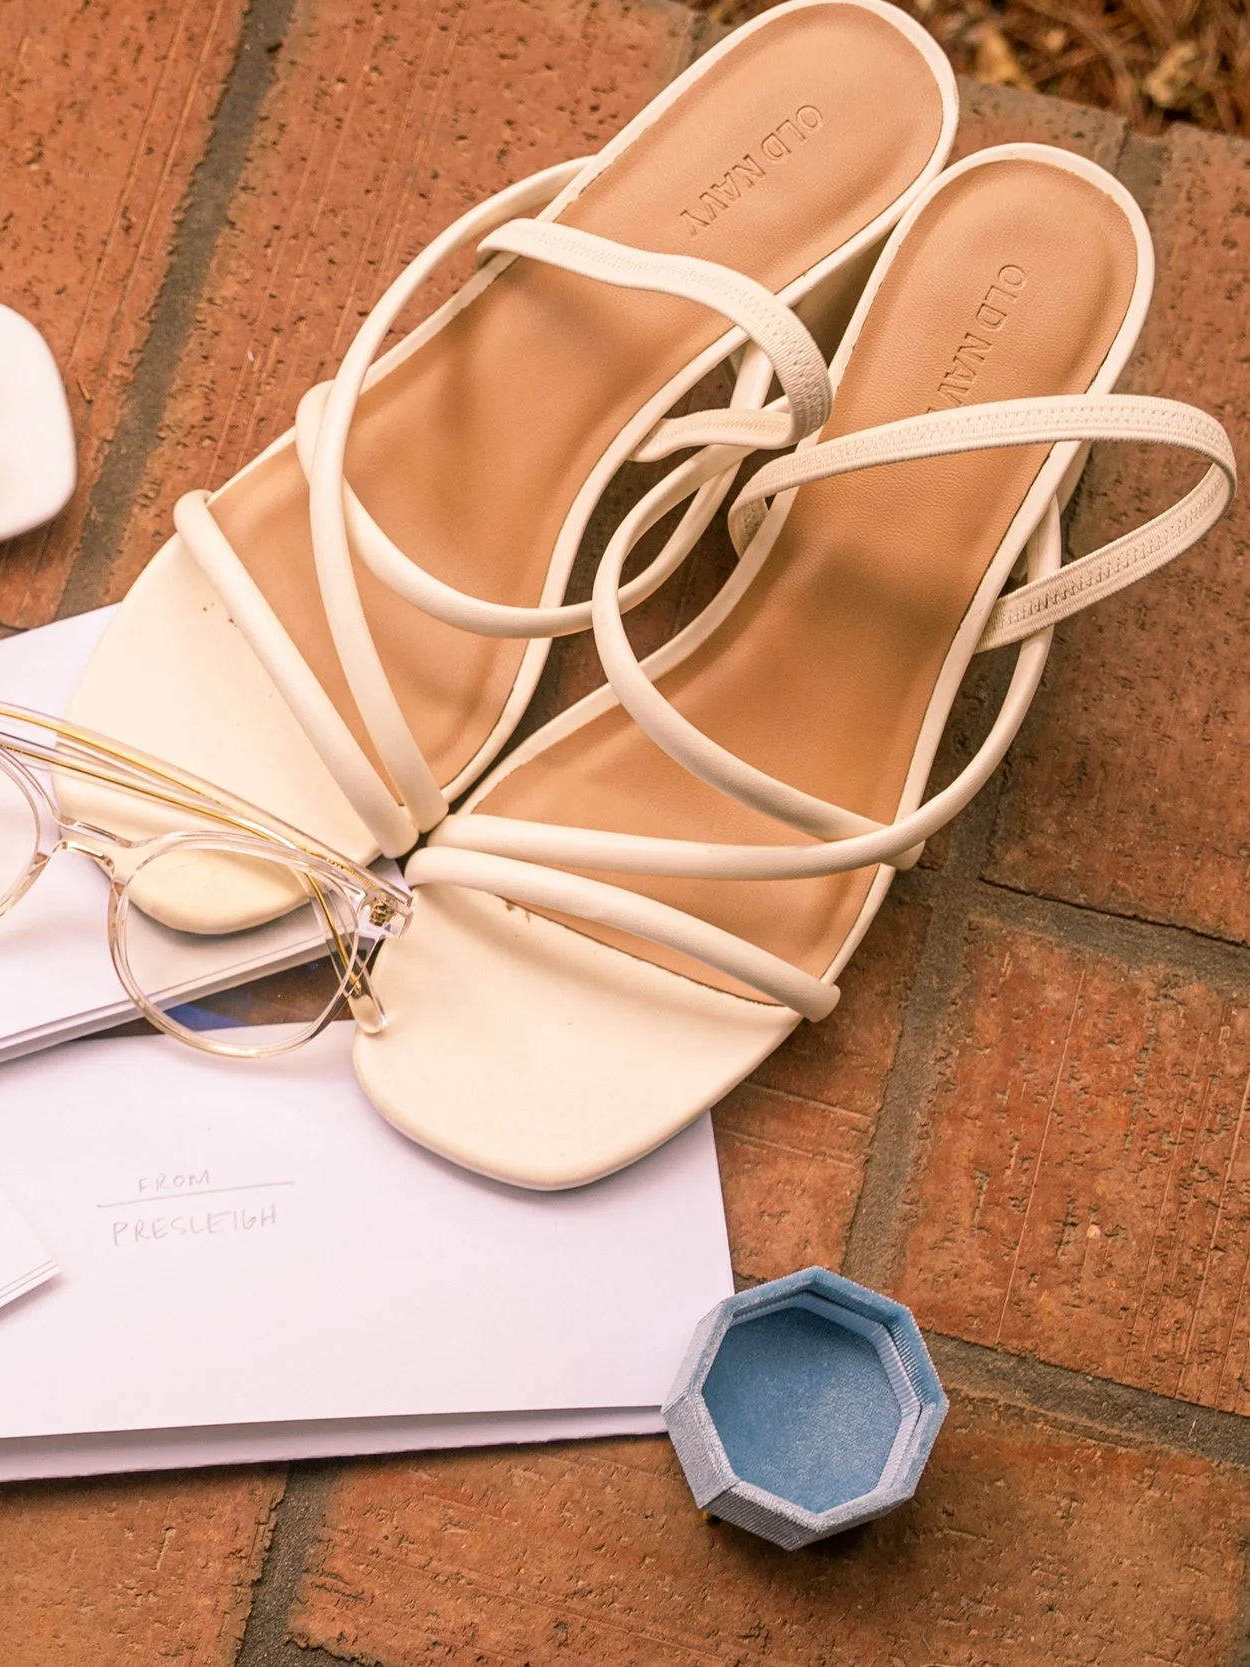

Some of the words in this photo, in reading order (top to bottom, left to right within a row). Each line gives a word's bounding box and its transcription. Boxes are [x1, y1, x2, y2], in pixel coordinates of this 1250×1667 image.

[760, 104, 825, 163] OLD
[679, 153, 768, 238] NAVY
[975, 264, 1027, 332] OLD
[927, 331, 995, 414] NAV
[137, 1169, 211, 1194] FROM
[112, 1203, 278, 1248] PRESLEIGH
